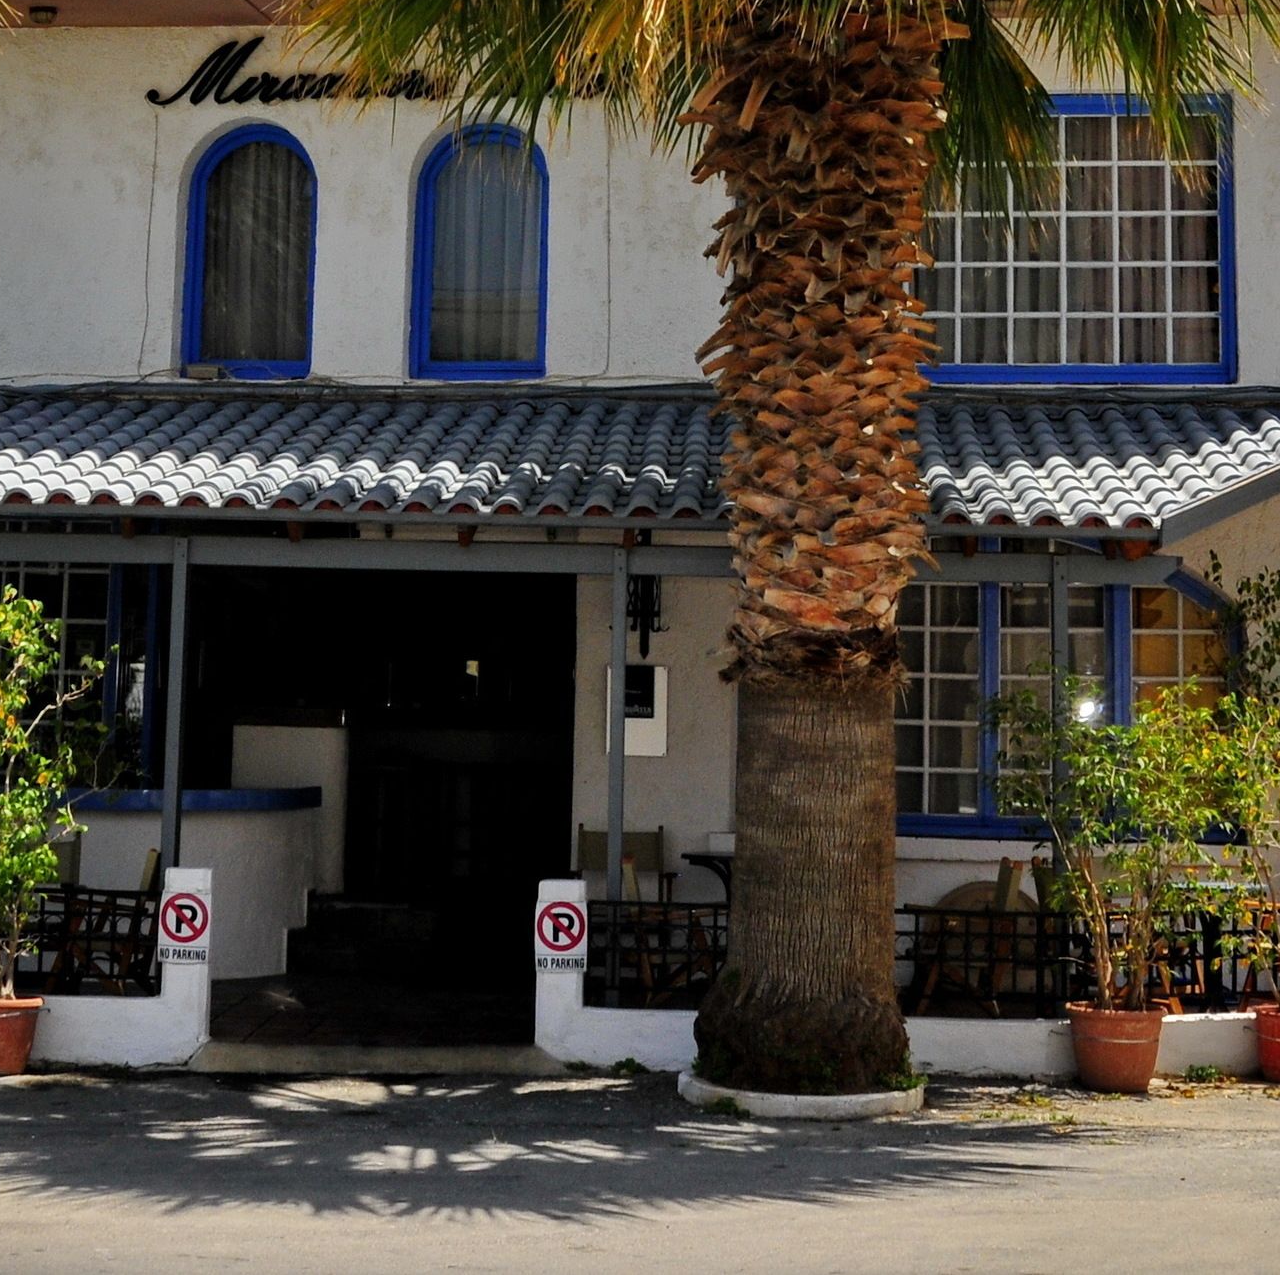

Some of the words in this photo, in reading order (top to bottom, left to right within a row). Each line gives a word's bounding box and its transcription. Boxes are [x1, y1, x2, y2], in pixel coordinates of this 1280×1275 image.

[160, 948, 170, 960] NO
[172, 948, 207, 961] PARKING
[537, 957, 548, 968] NO
[551, 957, 585, 969] PARKING
